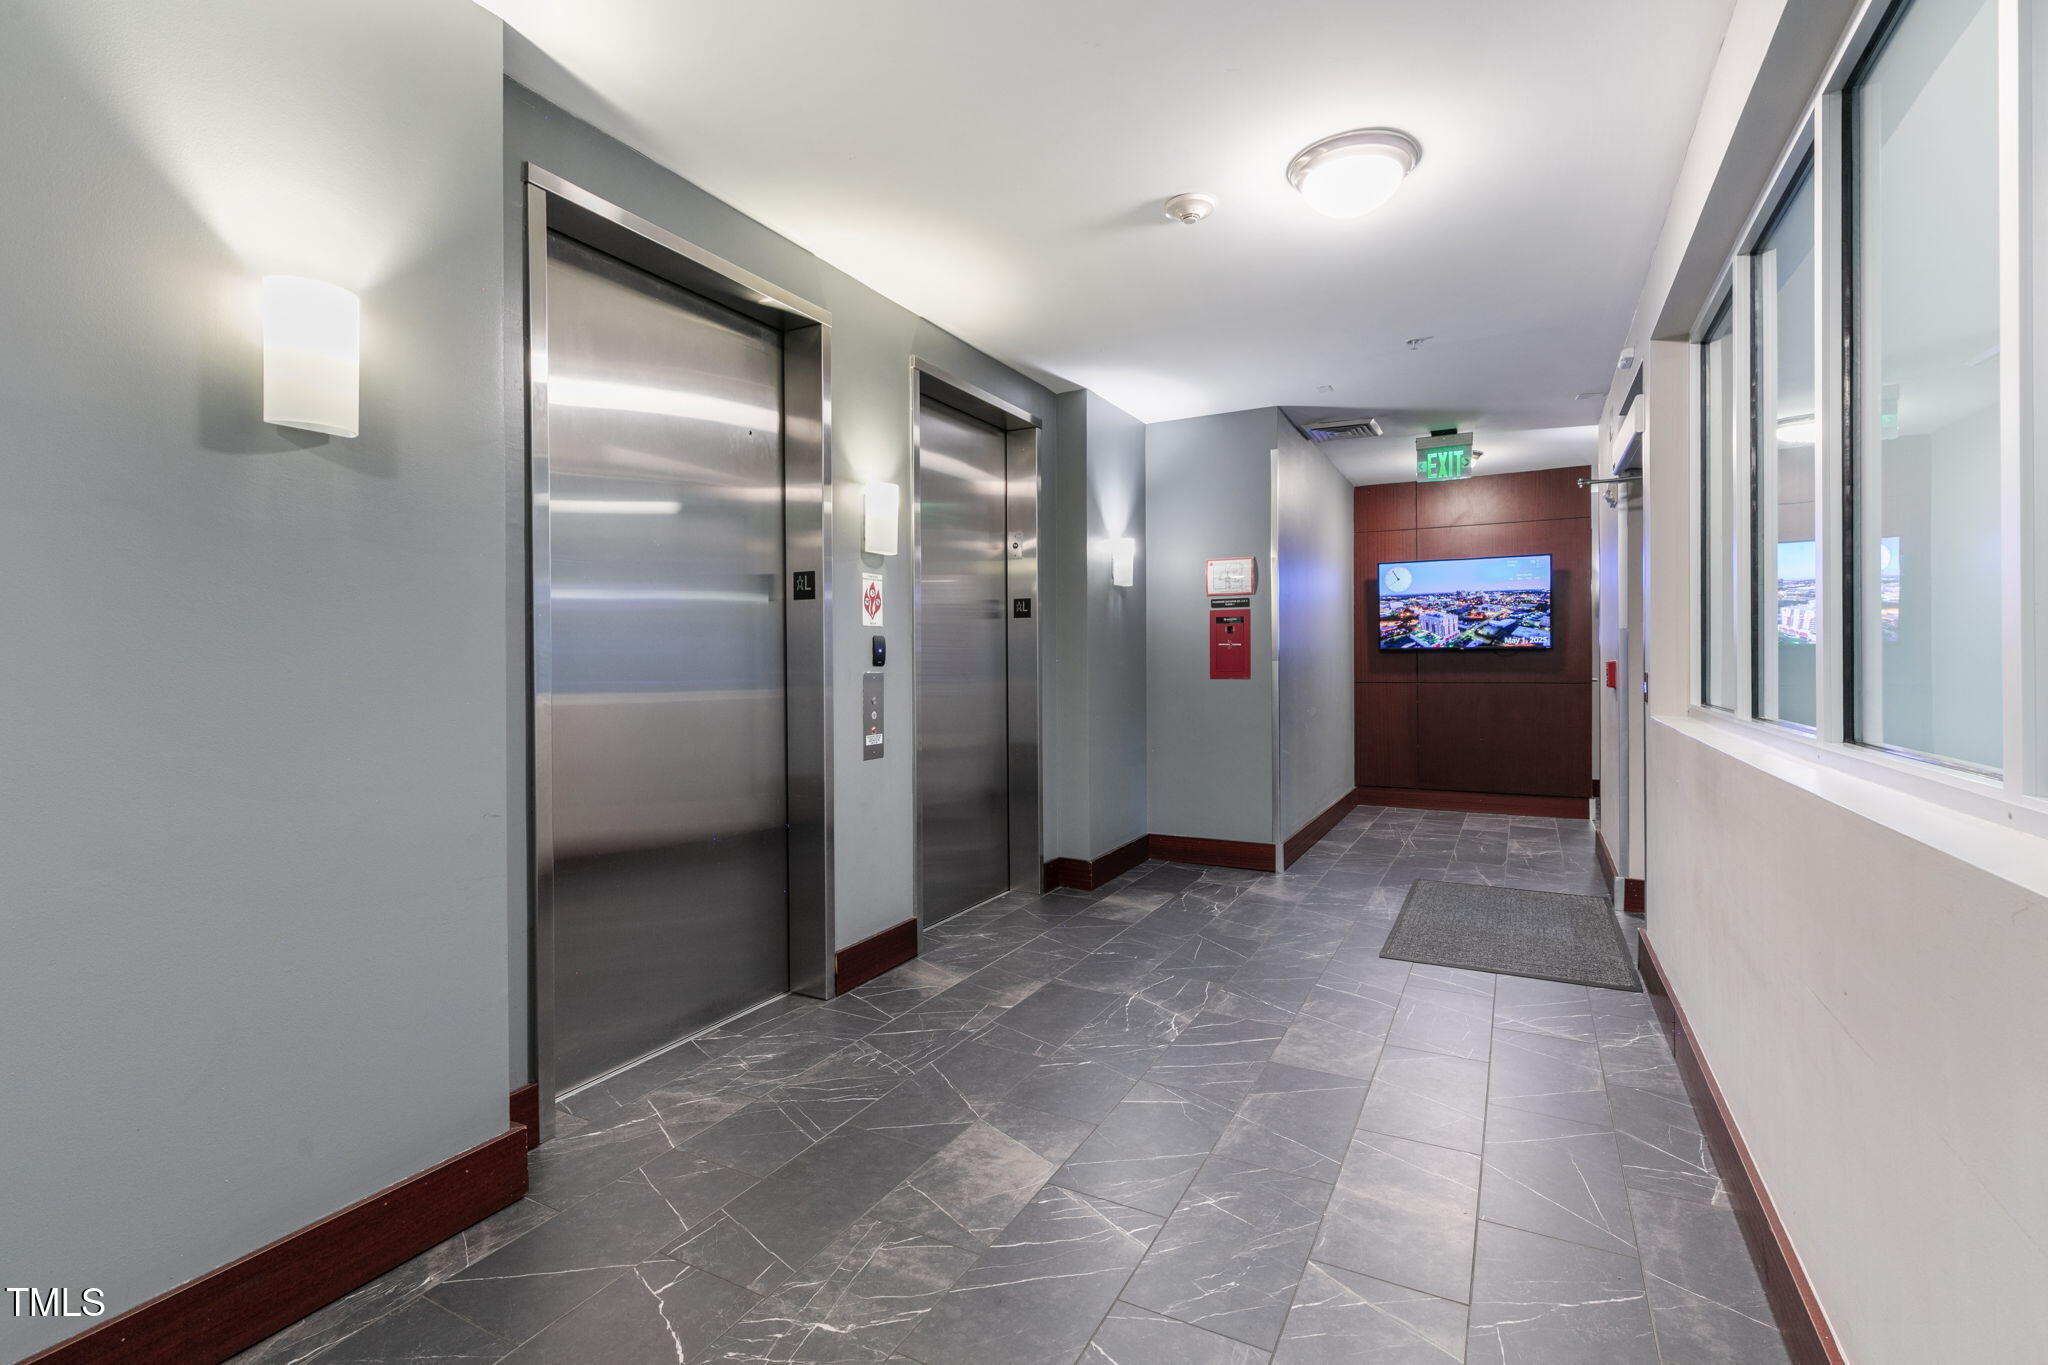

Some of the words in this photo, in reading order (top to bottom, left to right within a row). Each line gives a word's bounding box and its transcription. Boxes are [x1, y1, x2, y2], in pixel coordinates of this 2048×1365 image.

[1427, 450, 1464, 479] EXIT
[1504, 637, 1520, 645] May
[1530, 636, 1548, 644] 2025
